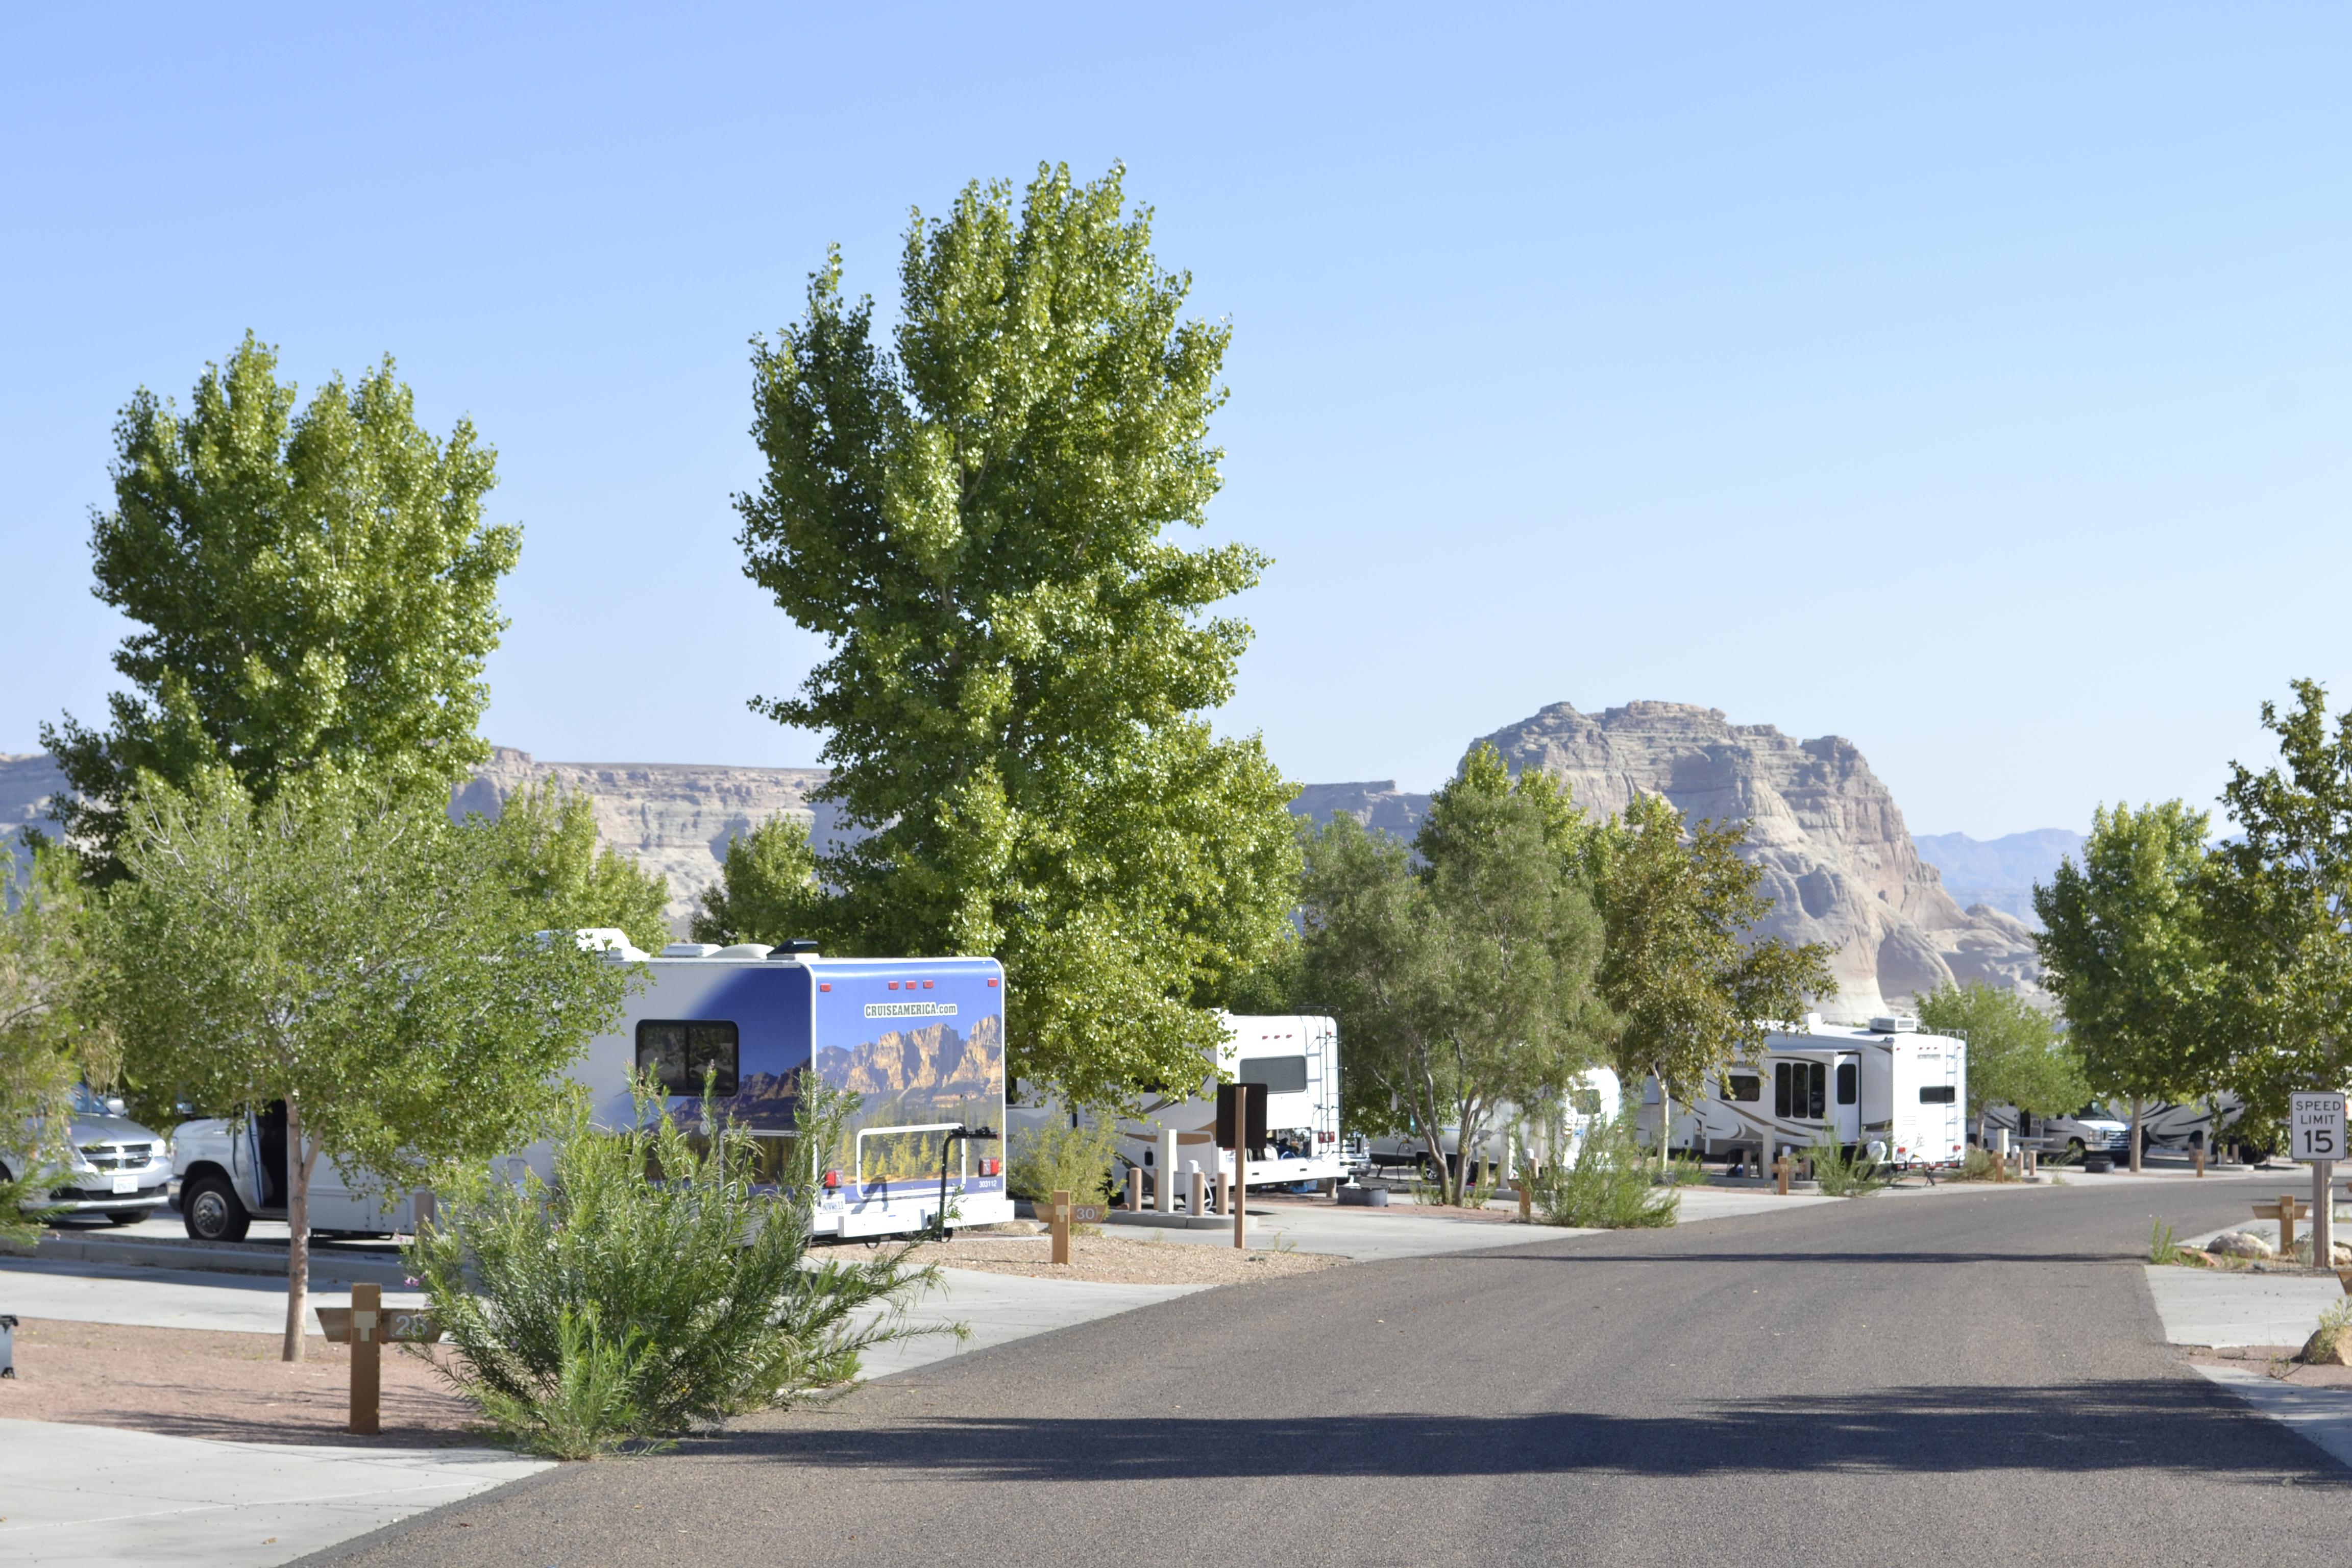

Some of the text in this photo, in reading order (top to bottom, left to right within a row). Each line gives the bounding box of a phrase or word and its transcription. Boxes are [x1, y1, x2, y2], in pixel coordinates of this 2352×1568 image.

[865, 1004, 956, 1016] CRUISEAMERICA.com
[2296, 1101, 2341, 1111] SPEED
[2301, 1115, 2335, 1124] LIMIT
[2304, 1130, 2333, 1154] 15
[978, 1180, 997, 1188] 303112
[1077, 1208, 1095, 1219] 30
